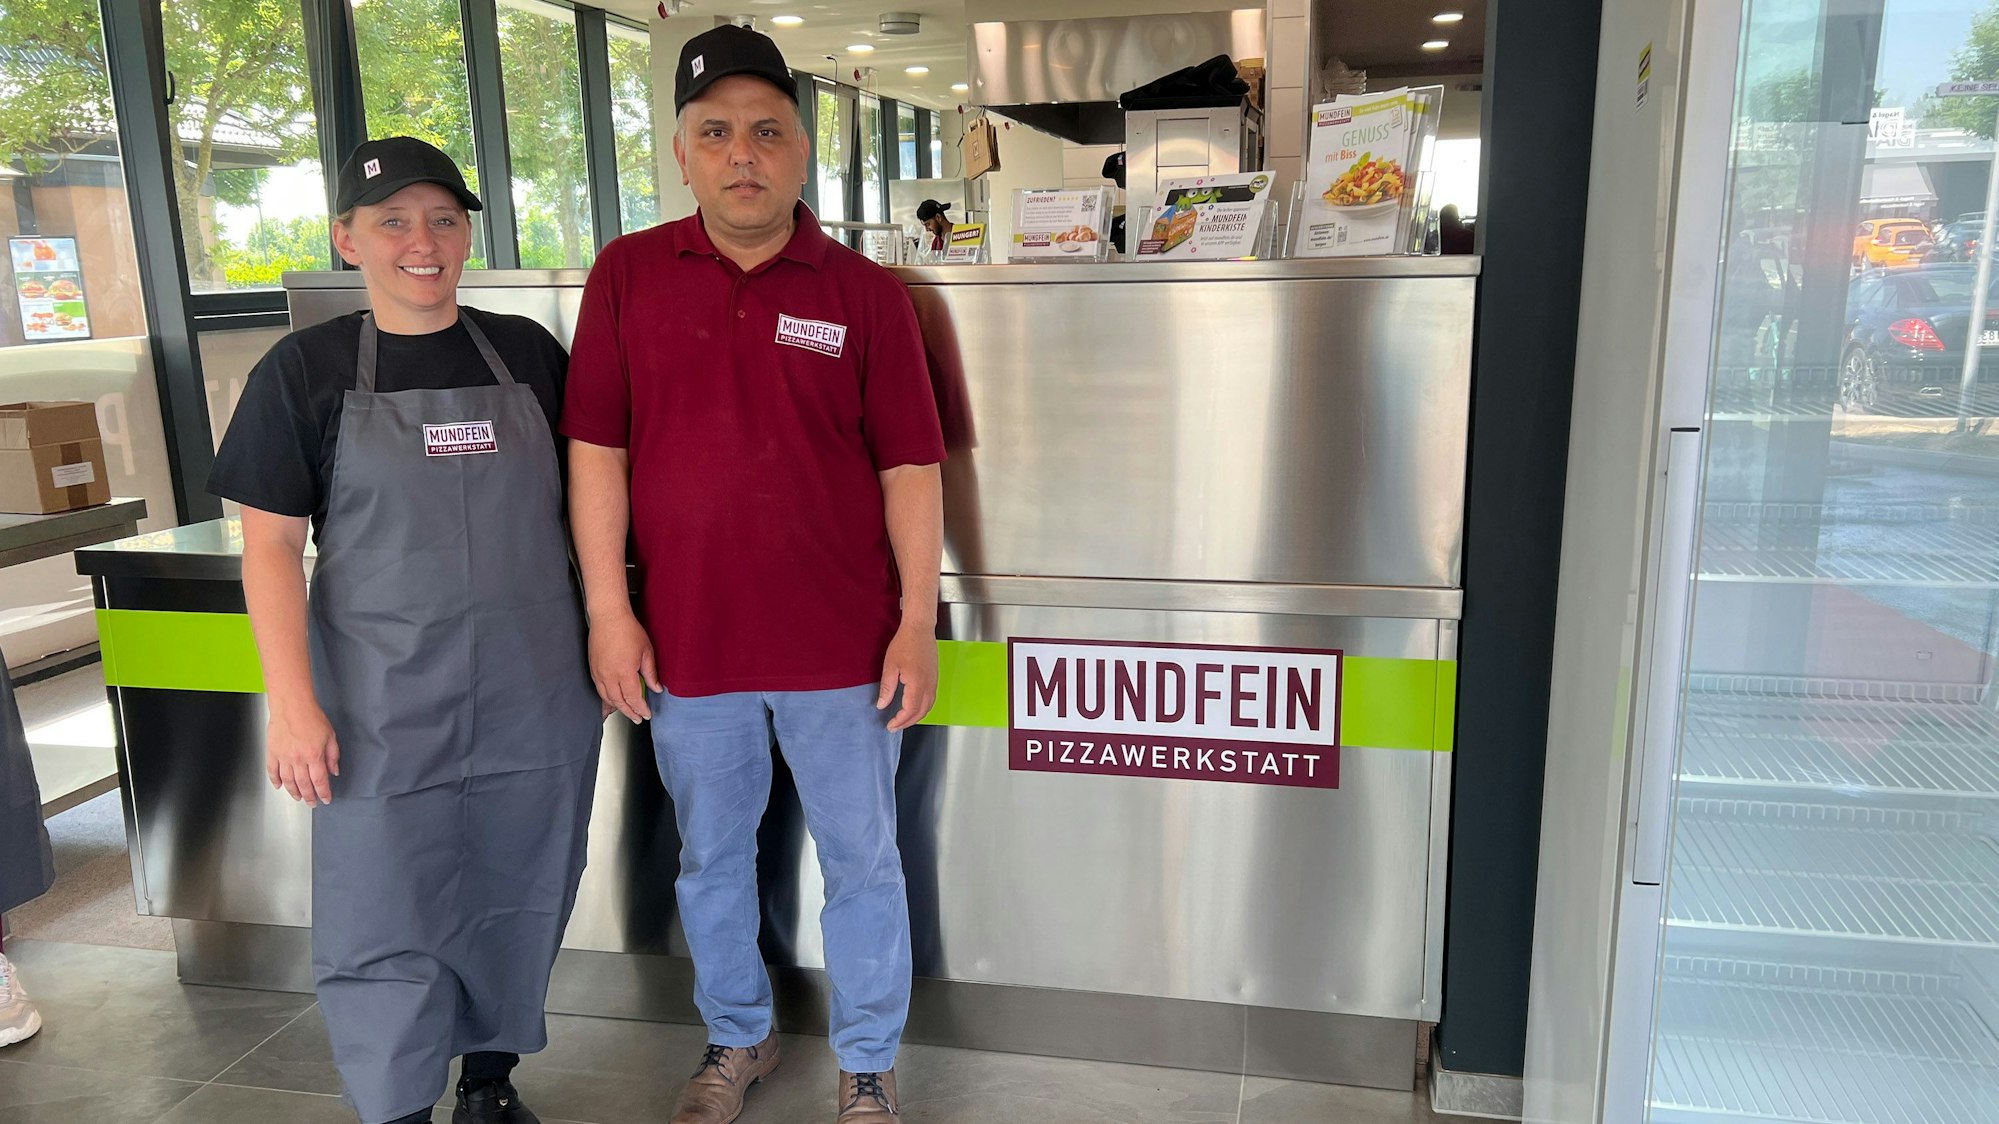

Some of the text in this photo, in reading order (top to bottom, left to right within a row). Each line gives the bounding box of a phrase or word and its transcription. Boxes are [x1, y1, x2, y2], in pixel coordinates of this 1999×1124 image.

[693, 58, 702, 74] M
[1950, 83, 1980, 93] KEINE
[1319, 108, 1351, 121] MUNDFEIN
[1342, 123, 1389, 147] GENUSS
[1325, 149, 1357, 163] mit Biss
[367, 162, 377, 175] M
[952, 229, 980, 241] HUNGER?
[1199, 222, 1246, 233] KINDERKISTE
[783, 320, 841, 344] MUNDFEIN
[780, 334, 838, 354] PIZZAWERKSTATT
[429, 426, 490, 443] MUNDFEIN
[431, 443, 492, 453] PIZZAWERKSTATT
[1026, 656, 1322, 731] MUNDFEIN
[1026, 739, 1321, 778] PIZZAWERKSTATT
